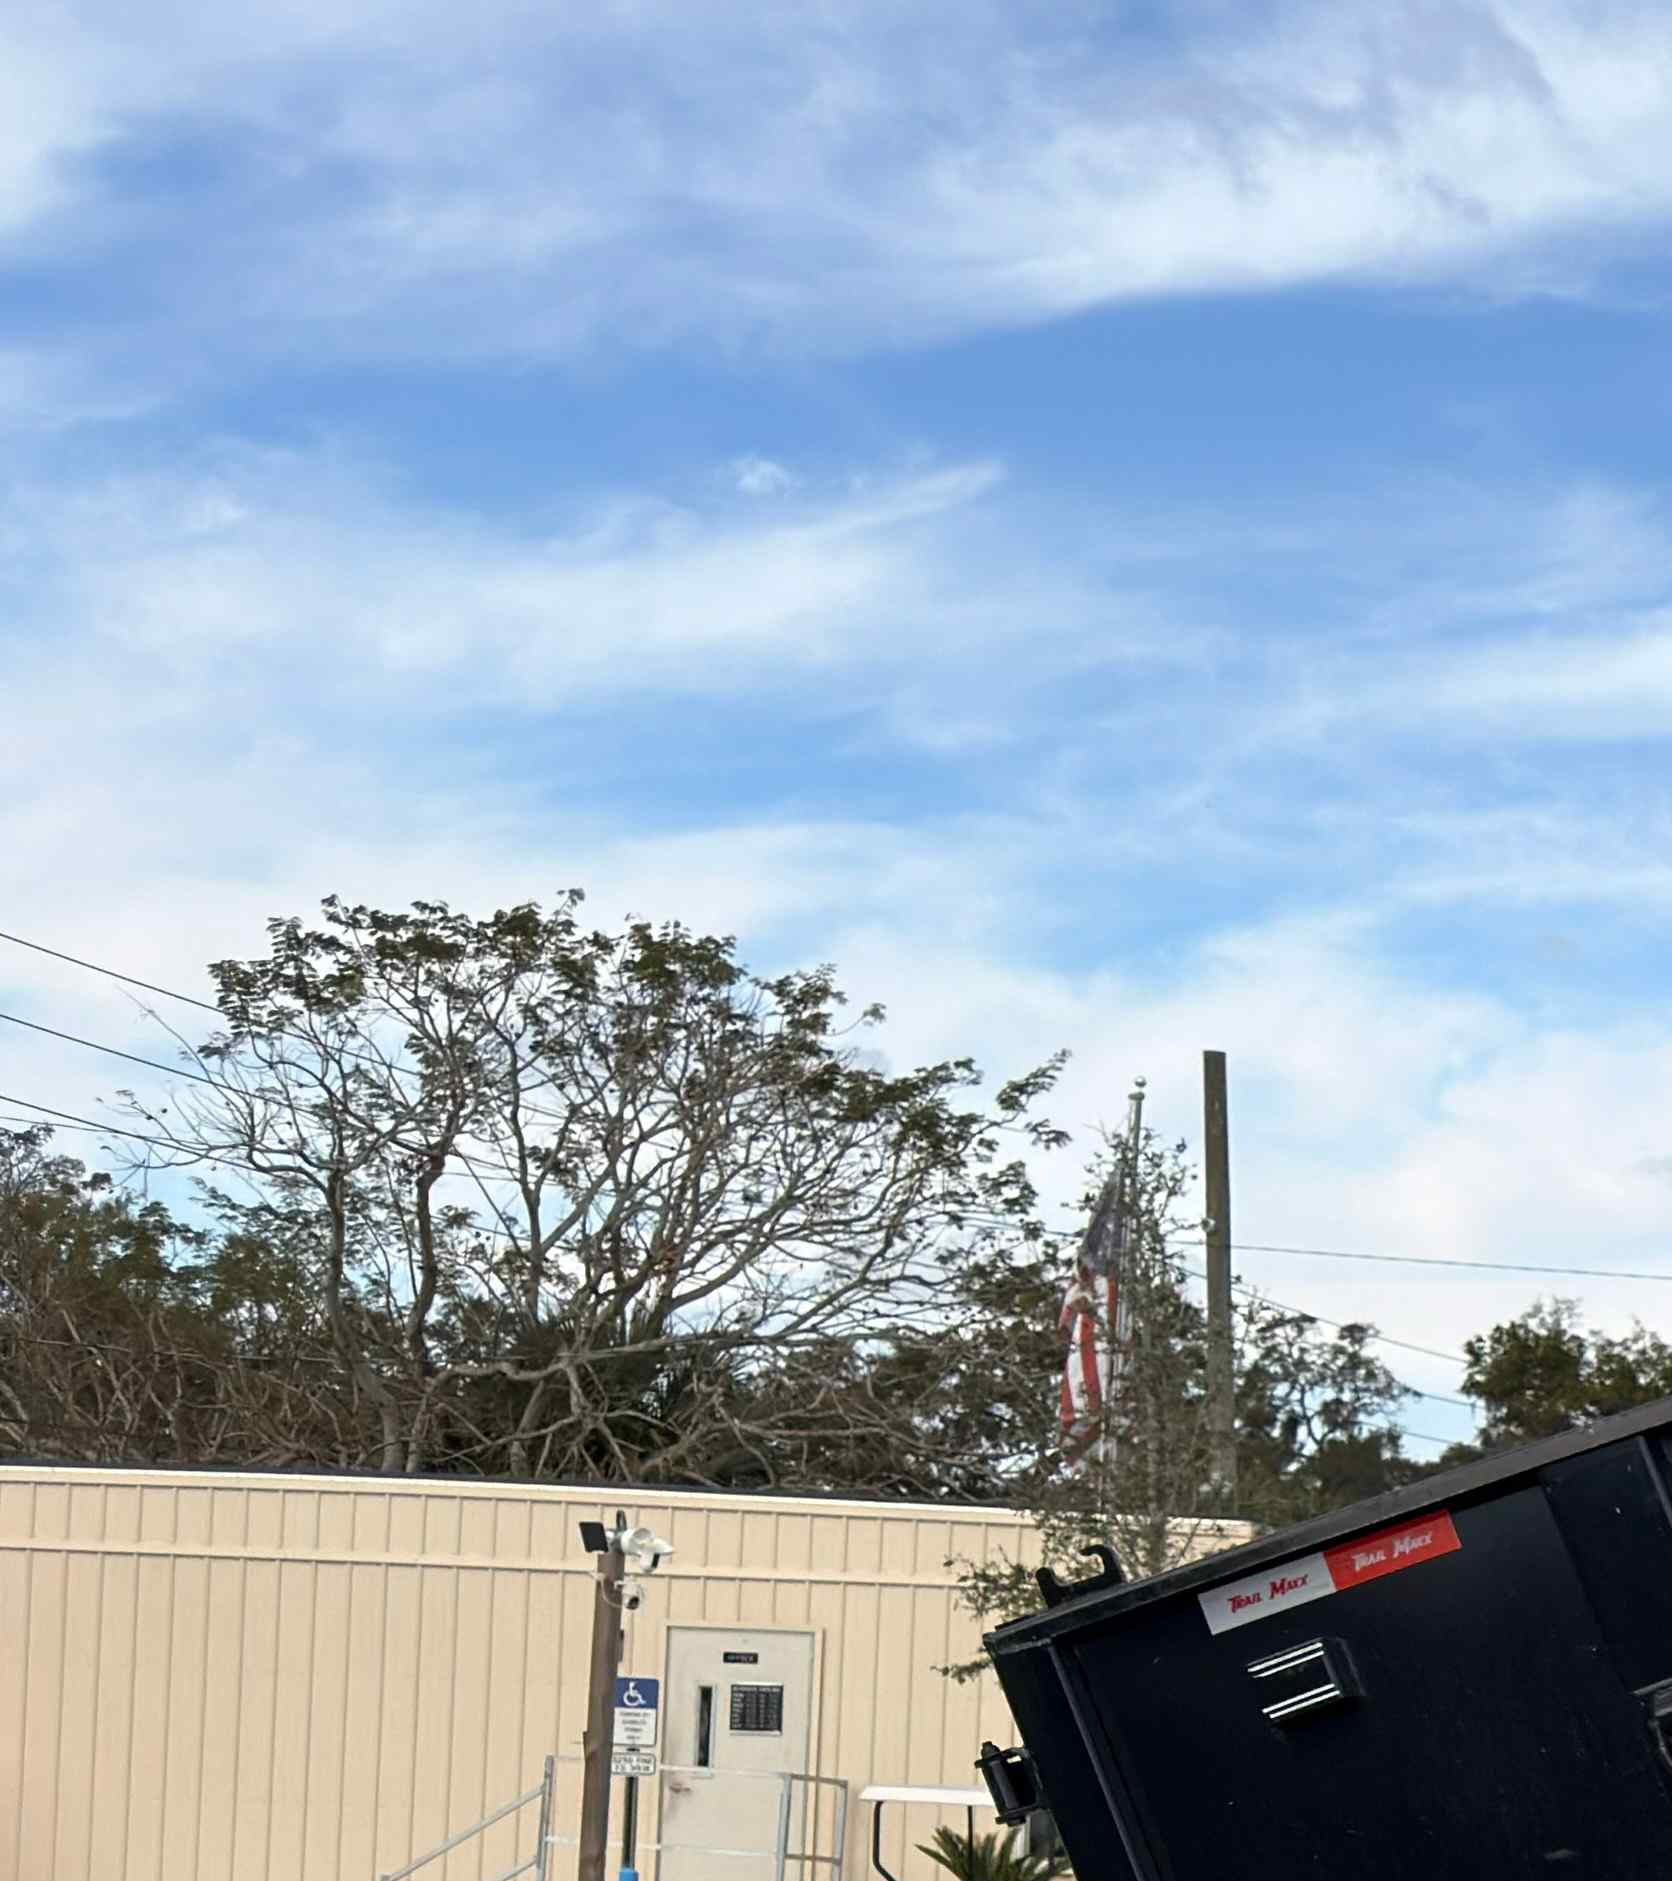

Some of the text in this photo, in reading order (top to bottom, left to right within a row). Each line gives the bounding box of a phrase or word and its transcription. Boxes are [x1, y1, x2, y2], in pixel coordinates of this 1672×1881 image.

[1352, 1531, 1433, 1571] TRAIL MAXX
[1228, 1573, 1309, 1613] TRAIL MAXX
